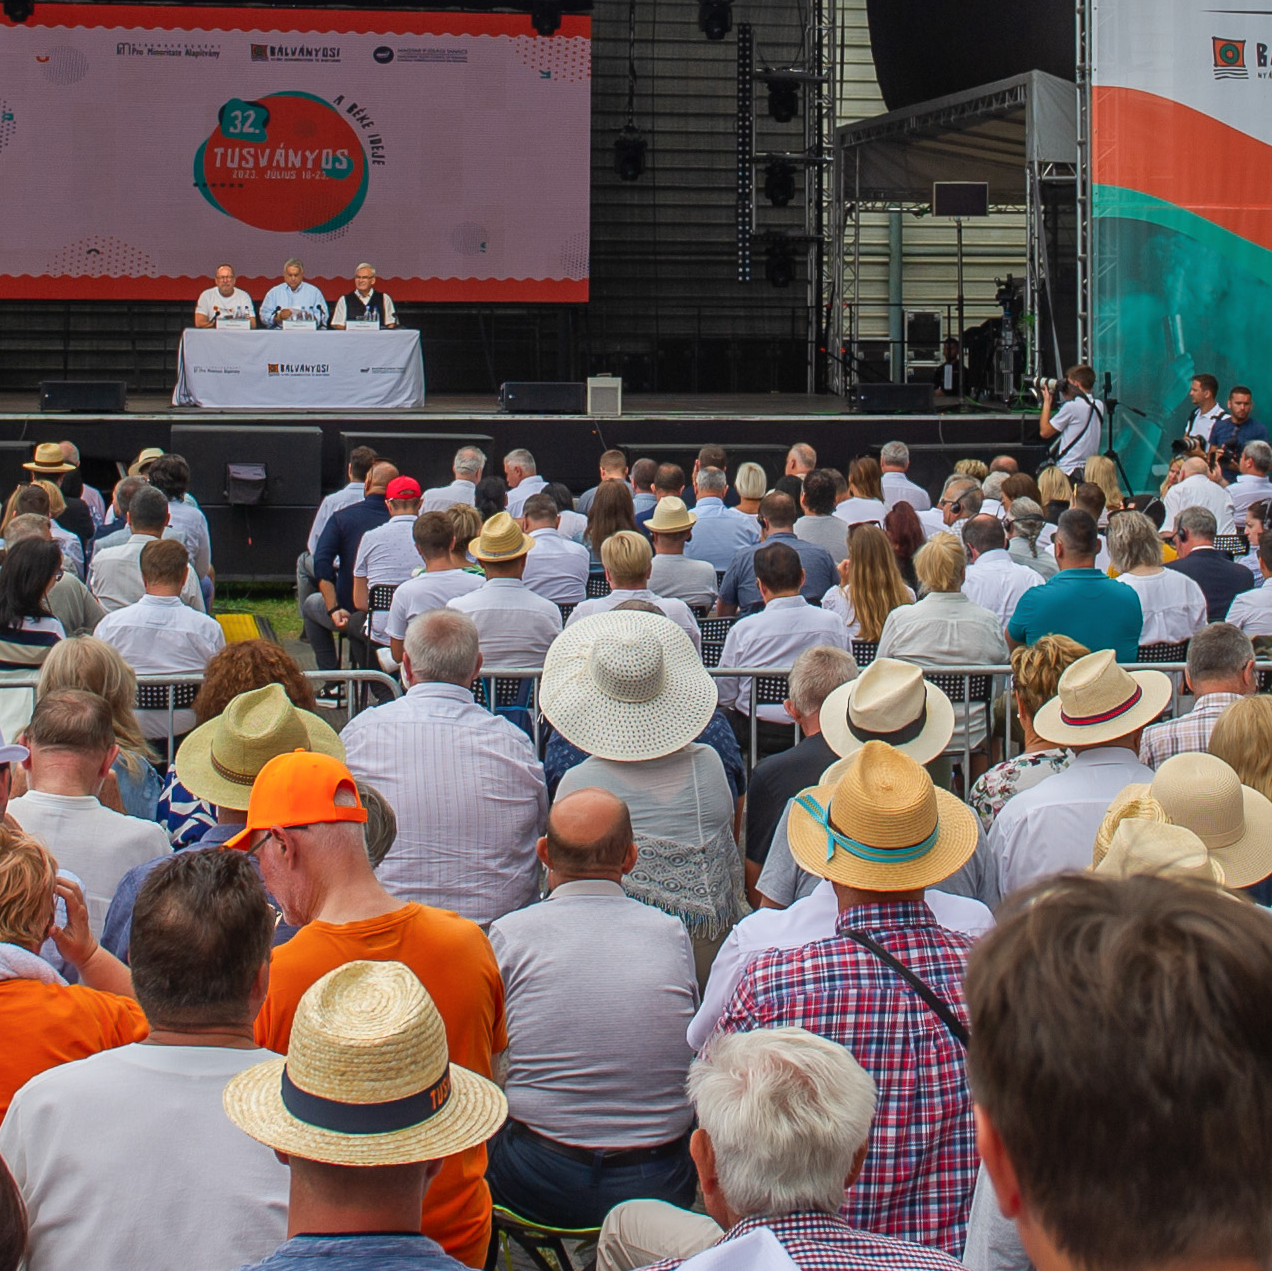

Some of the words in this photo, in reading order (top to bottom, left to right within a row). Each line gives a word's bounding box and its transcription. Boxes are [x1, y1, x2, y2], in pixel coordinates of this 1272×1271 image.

[269, 45, 341, 58] BÁLVÁNYOSI
[229, 110, 260, 134] 32.
[333, 94, 345, 106] A
[346, 102, 375, 130] BÉKE
[368, 133, 386, 166] IDEJE
[214, 142, 350, 170] TUSVÁNYOS
